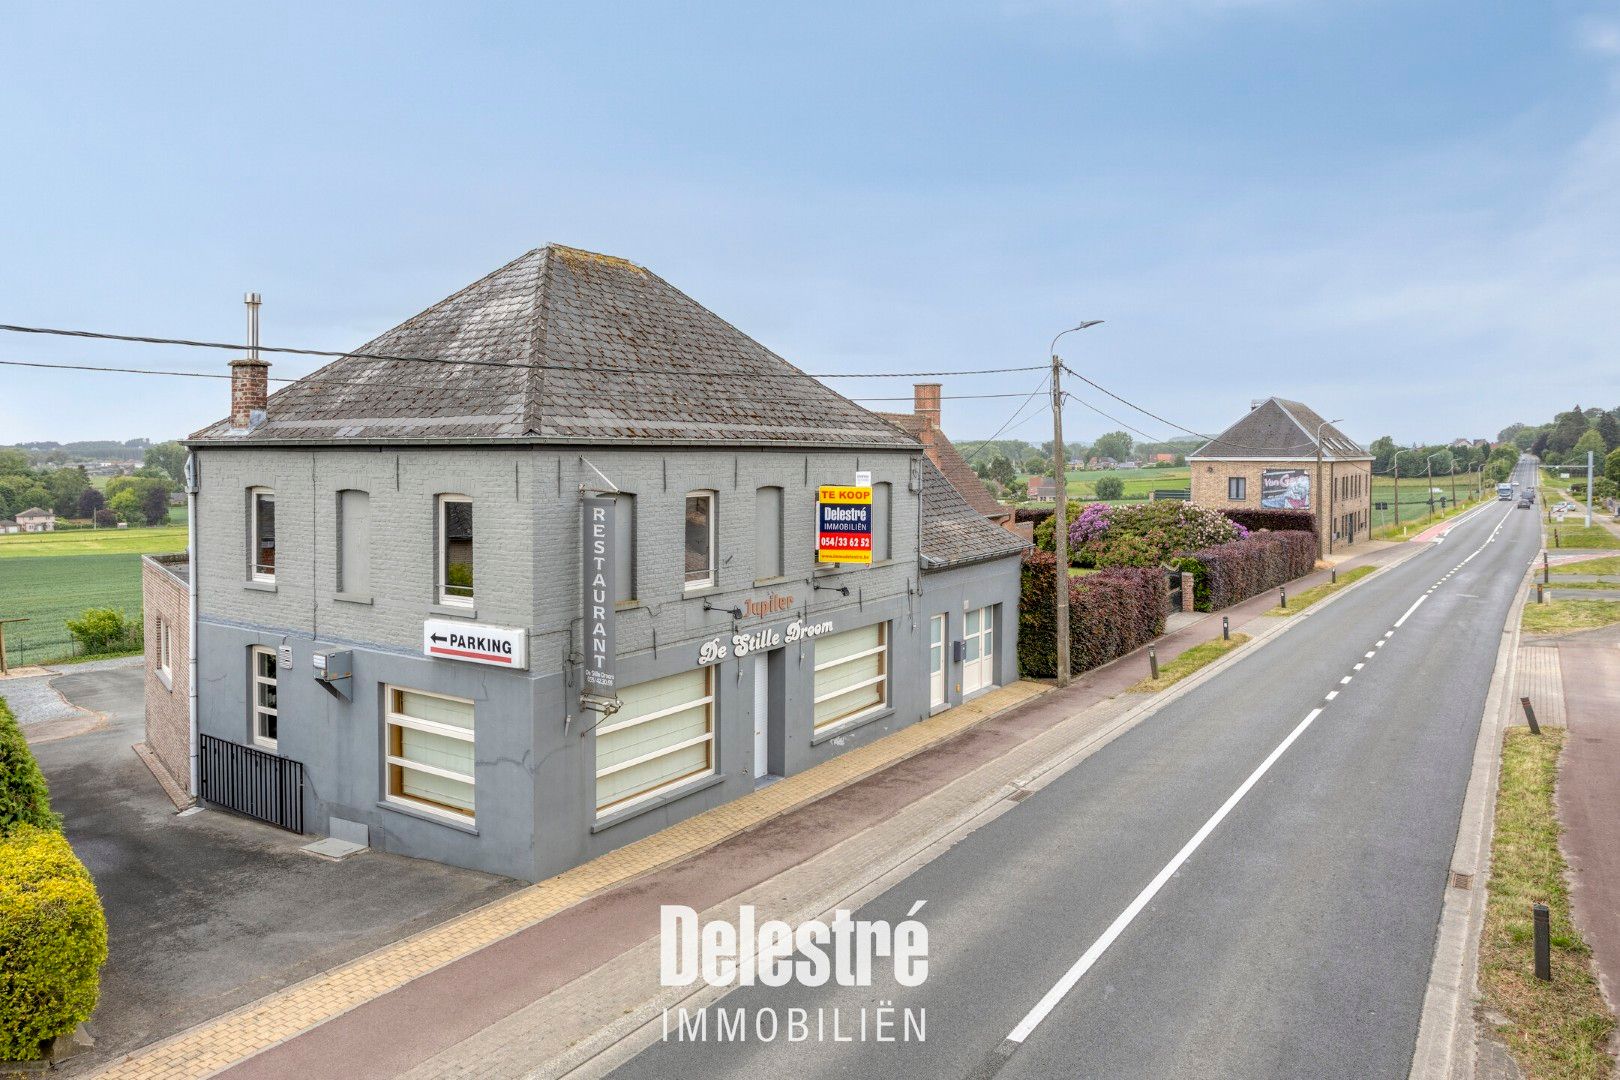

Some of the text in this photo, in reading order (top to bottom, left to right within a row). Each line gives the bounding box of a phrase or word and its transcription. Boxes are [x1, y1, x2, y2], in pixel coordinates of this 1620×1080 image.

[822, 491, 870, 499] TE KOOP
[825, 506, 867, 521] Delestré
[824, 522, 867, 531] IMMOBILIËN
[821, 536, 870, 547] 054/33 62 52
[592, 507, 607, 669] RESTAURANT
[450, 633, 512, 655] PARKING
[698, 619, 833, 665] De Stille Droom
